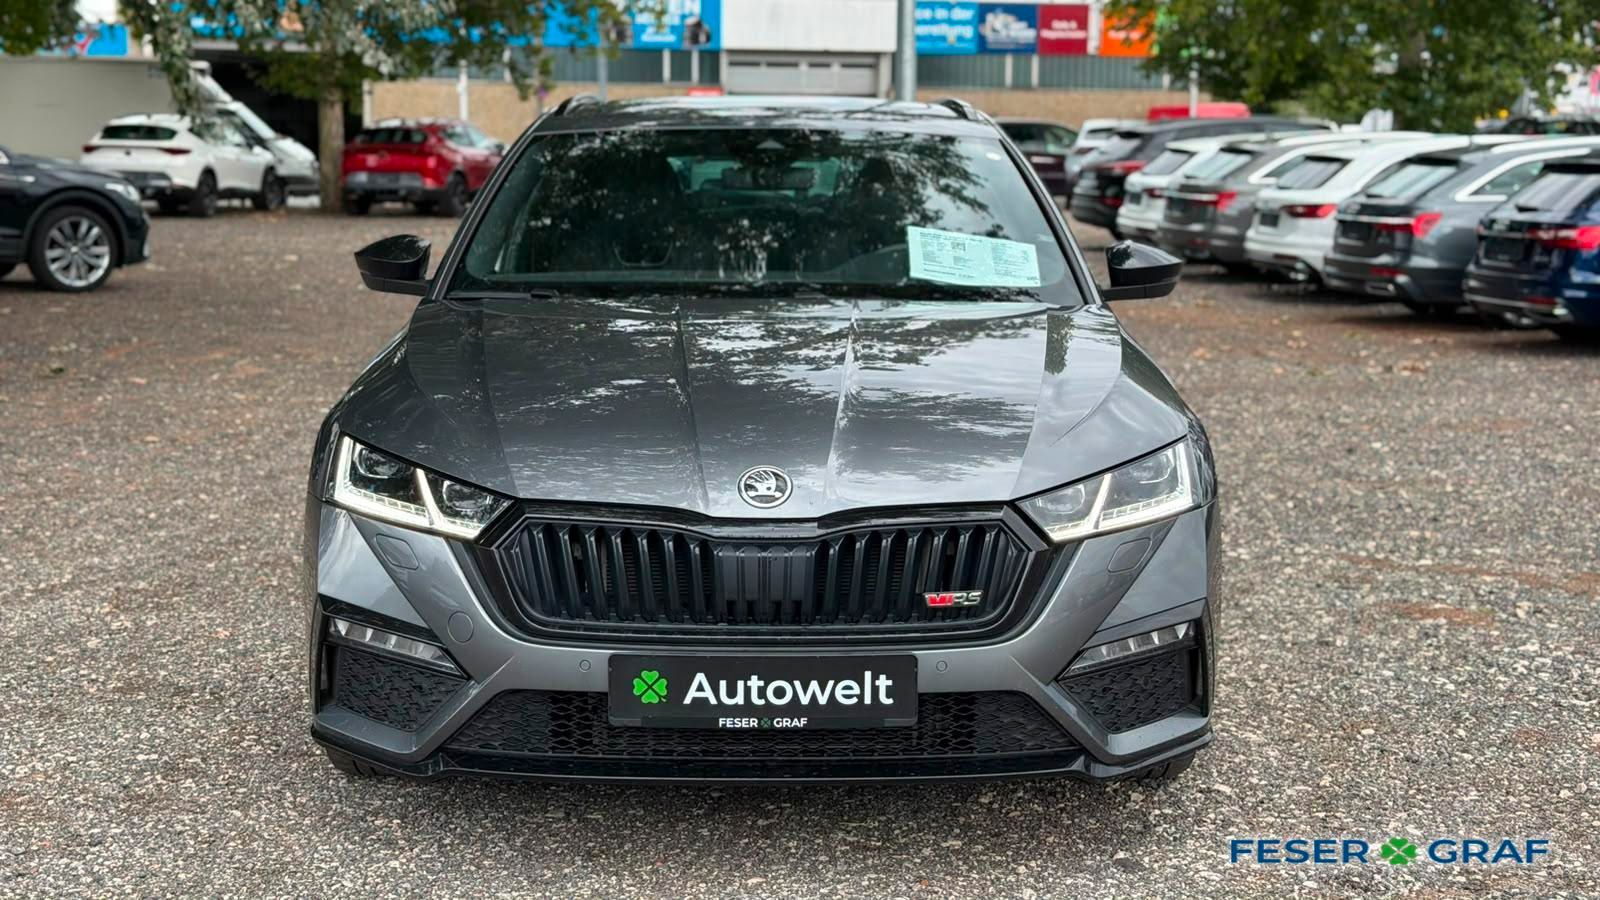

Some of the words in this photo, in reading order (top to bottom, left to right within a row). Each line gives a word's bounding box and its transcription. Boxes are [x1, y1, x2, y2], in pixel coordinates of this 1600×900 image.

[683, 670, 894, 706] Autowelt
[719, 717, 758, 728] FESER
[773, 717, 808, 728] GRAF
